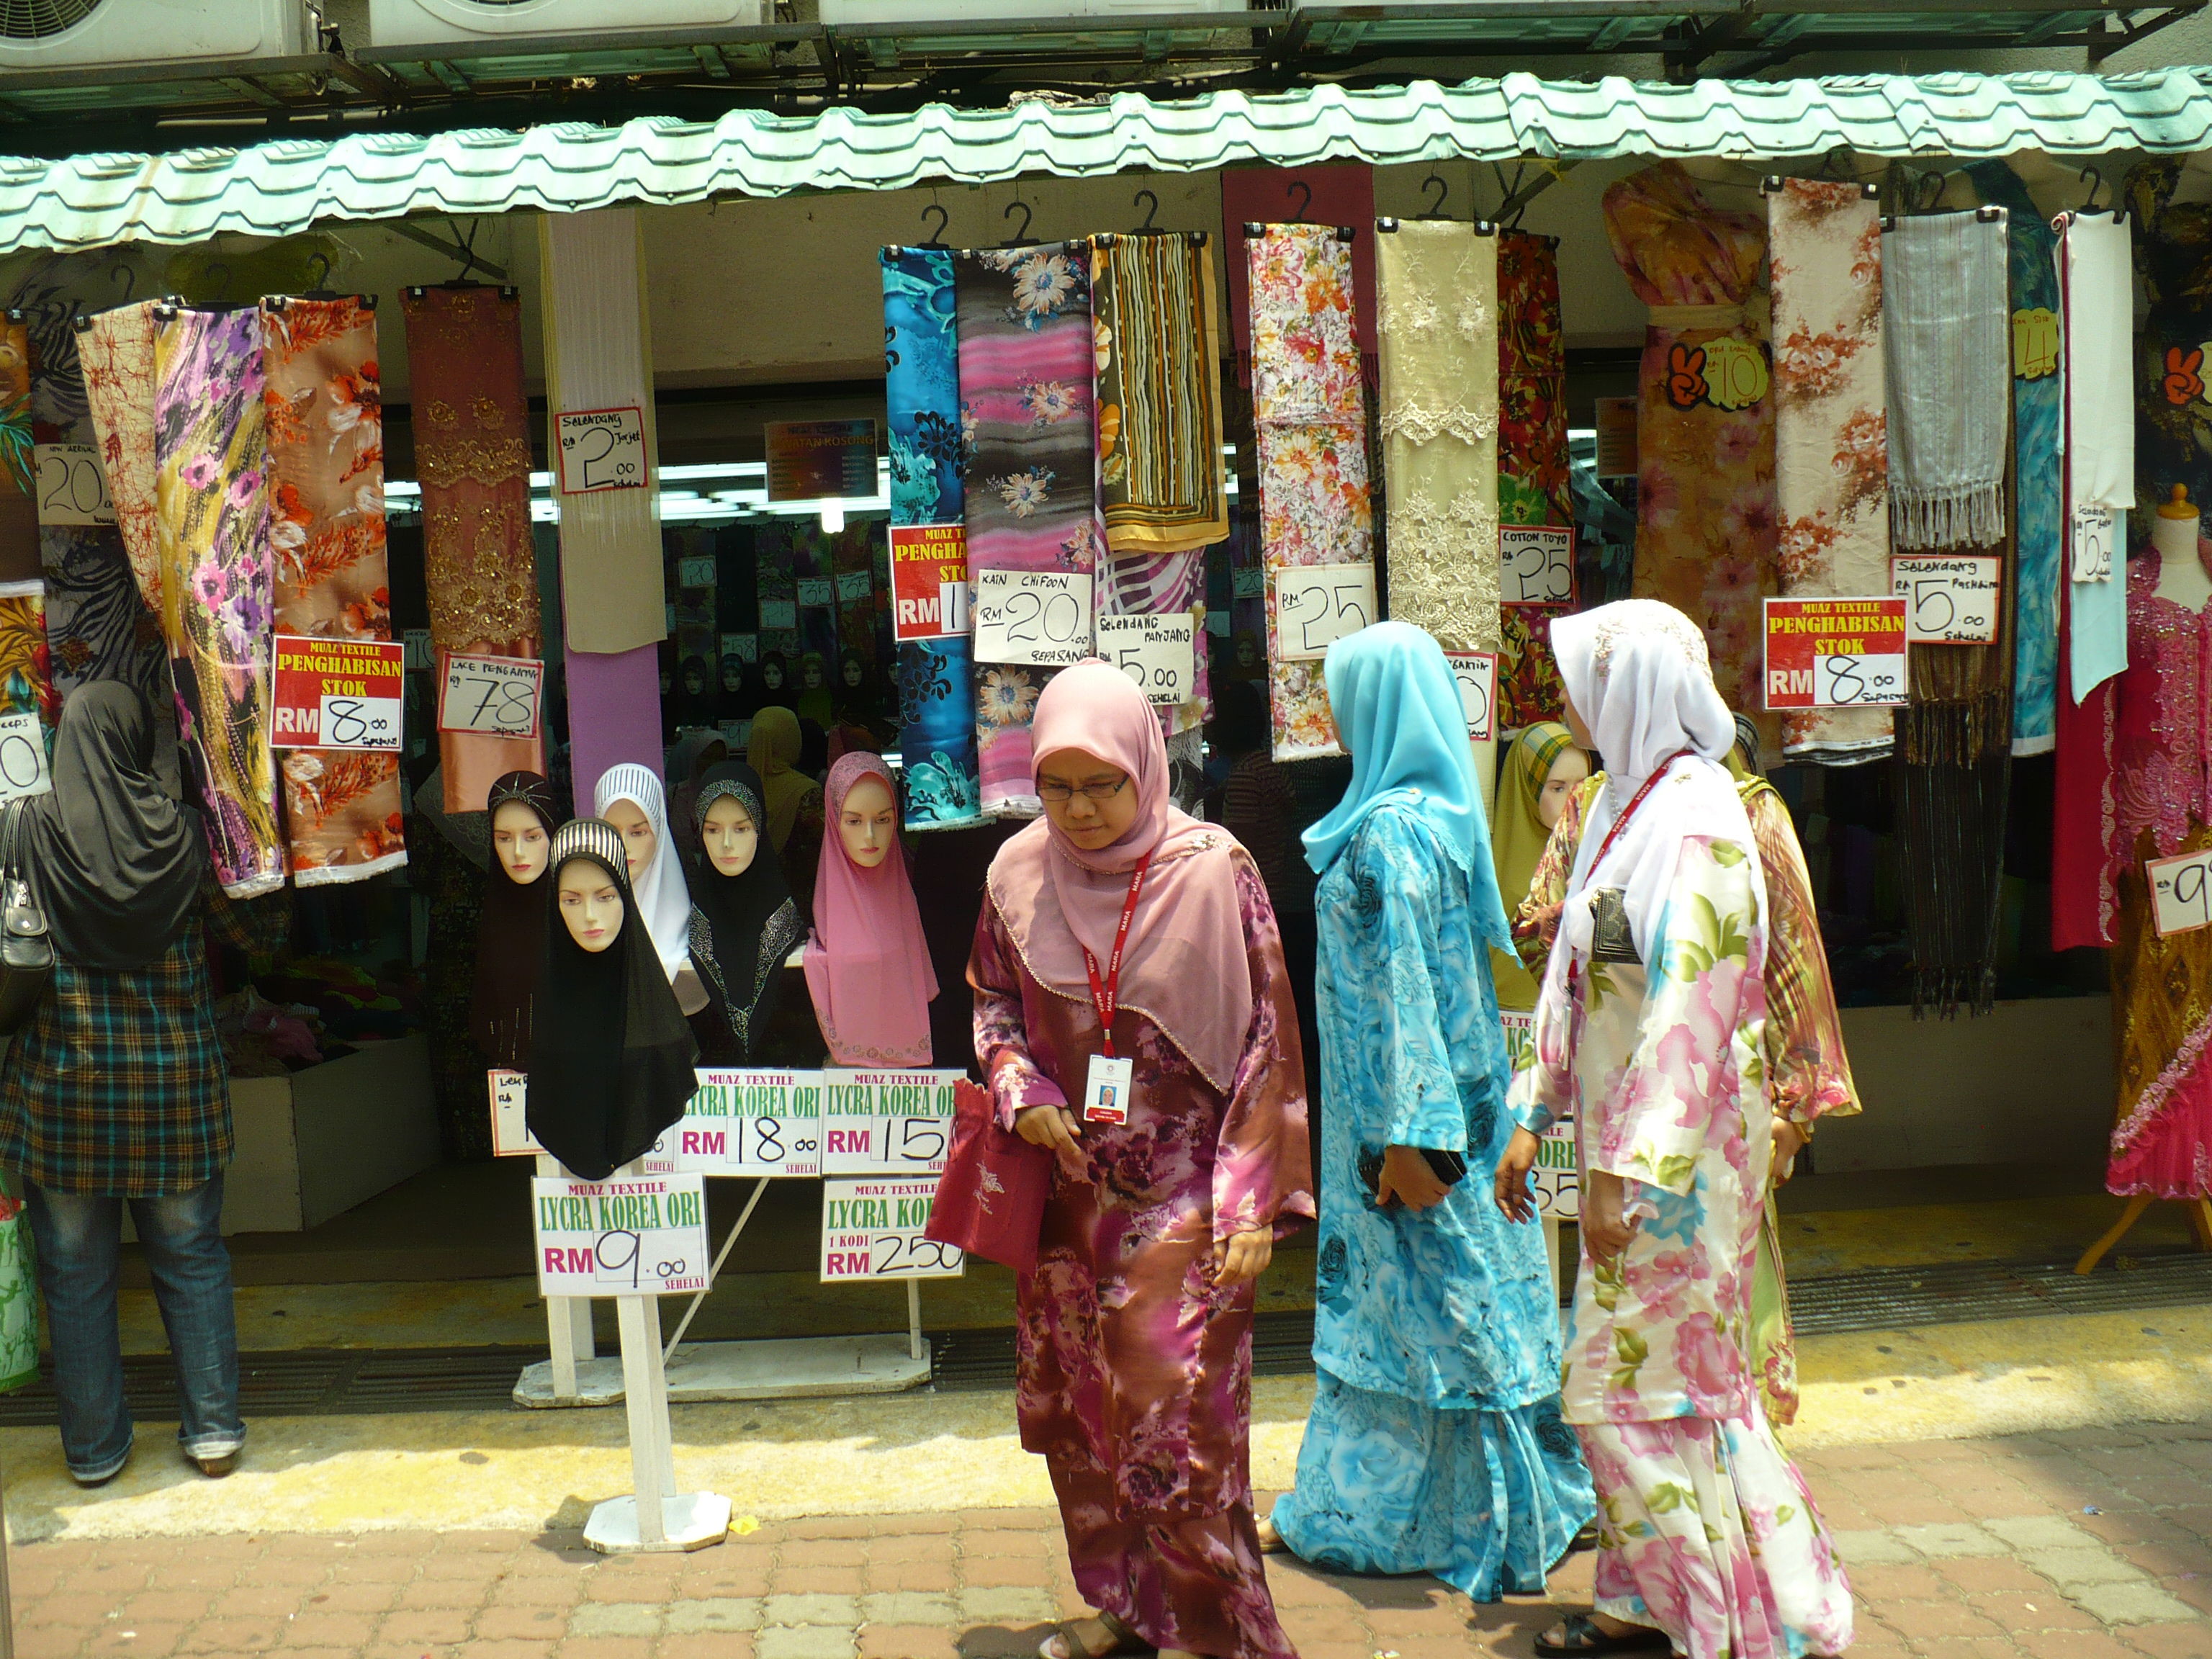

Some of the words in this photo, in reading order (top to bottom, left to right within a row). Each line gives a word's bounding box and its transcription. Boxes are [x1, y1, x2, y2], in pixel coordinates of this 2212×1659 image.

[1724, 354, 1757, 399] 10
[824, 435, 874, 446] KOSONG
[44, 457, 102, 513] 20
[925, 529, 953, 540] MUAZ
[1503, 532, 1539, 542] COTTON
[1543, 534, 1568, 545] TOYO
[894, 541, 968, 562] PENGHA
[940, 565, 968, 583] STO
[1516, 547, 1572, 601] 25
[1282, 593, 1300, 608] RM
[1802, 603, 1831, 613] MUAZ
[1835, 602, 1881, 613] TEXTILE
[899, 597, 940, 625] RM
[980, 607, 1002, 622] RM
[1769, 616, 1905, 634] PENGHABISAN
[1145, 628, 1191, 642] PANJANG
[310, 642, 338, 655] MUAZ
[341, 644, 381, 657] TEXTILE
[1815, 639, 1866, 655] STOK
[278, 654, 402, 678] PENGHABISAN
[451, 662, 475, 671] LACE
[322, 679, 367, 697] STOK
[1769, 670, 1813, 695] RM
[466, 678, 535, 726] 78
[275, 707, 319, 733] RM
[1635, 783, 1651, 801] MARA
[1133, 871, 1143, 892] MARA
[1120, 910, 1132, 932] MARA
[1111, 950, 1120, 972] MARA
[709, 1074, 740, 1084] MUAZ
[745, 1075, 795, 1086] TEXTILE
[855, 1074, 886, 1084] MUAZ
[889, 1075, 938, 1085] TEXTILE
[734, 1086, 788, 1117] KOREA
[793, 1087, 821, 1118] ORI
[827, 1085, 873, 1116] LYCRA
[879, 1085, 931, 1116] KOREA
[936, 1085, 956, 1116] OR
[683, 1131, 725, 1155] RM
[828, 1130, 870, 1153] RM
[884, 1118, 945, 1163] 15
[1534, 1140, 1577, 1169] ORE
[646, 1161, 675, 1172] SEHELAI
[786, 1164, 817, 1174] SEHELAI
[568, 1184, 605, 1196] MUAZ
[608, 1182, 667, 1195] TEXTILE
[855, 1186, 886, 1196] MUAZ
[890, 1184, 937, 1195] TEXTILE
[540, 1197, 593, 1231] LYCRA
[598, 1195, 661, 1230] KOREA
[667, 1191, 701, 1227] ORI
[827, 1199, 889, 1230] LYCRA
[830, 1236, 835, 1248] 1
[840, 1235, 869, 1247] KODI
[544, 1247, 594, 1274] RM
[827, 1252, 870, 1275] RM
[875, 1236, 963, 1274] 250
[665, 1277, 705, 1290] SEHELAI
